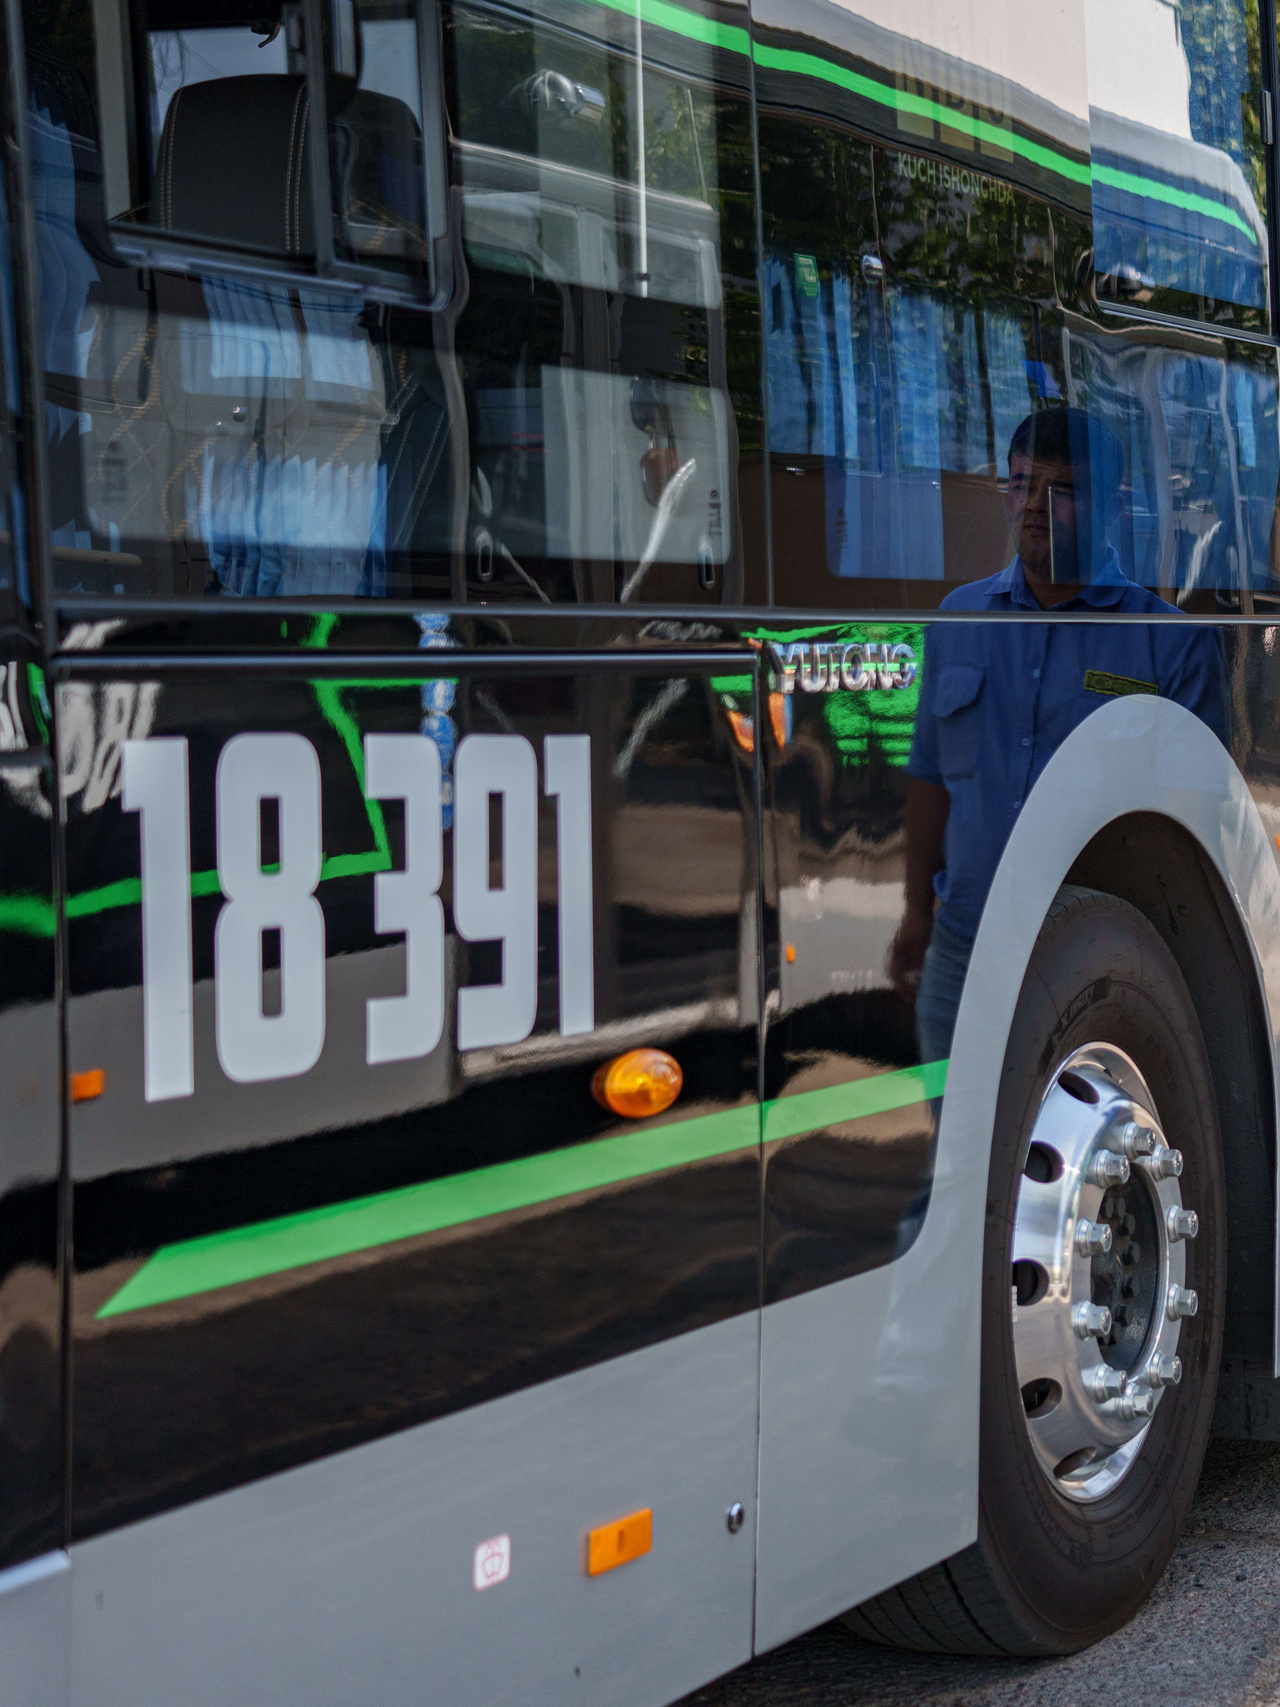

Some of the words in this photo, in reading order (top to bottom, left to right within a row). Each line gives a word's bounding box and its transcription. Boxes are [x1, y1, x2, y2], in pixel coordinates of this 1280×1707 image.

[898, 151, 936, 185] KUCH
[938, 163, 1016, 206] ISHONCHDA
[769, 643, 918, 694] YUTONG
